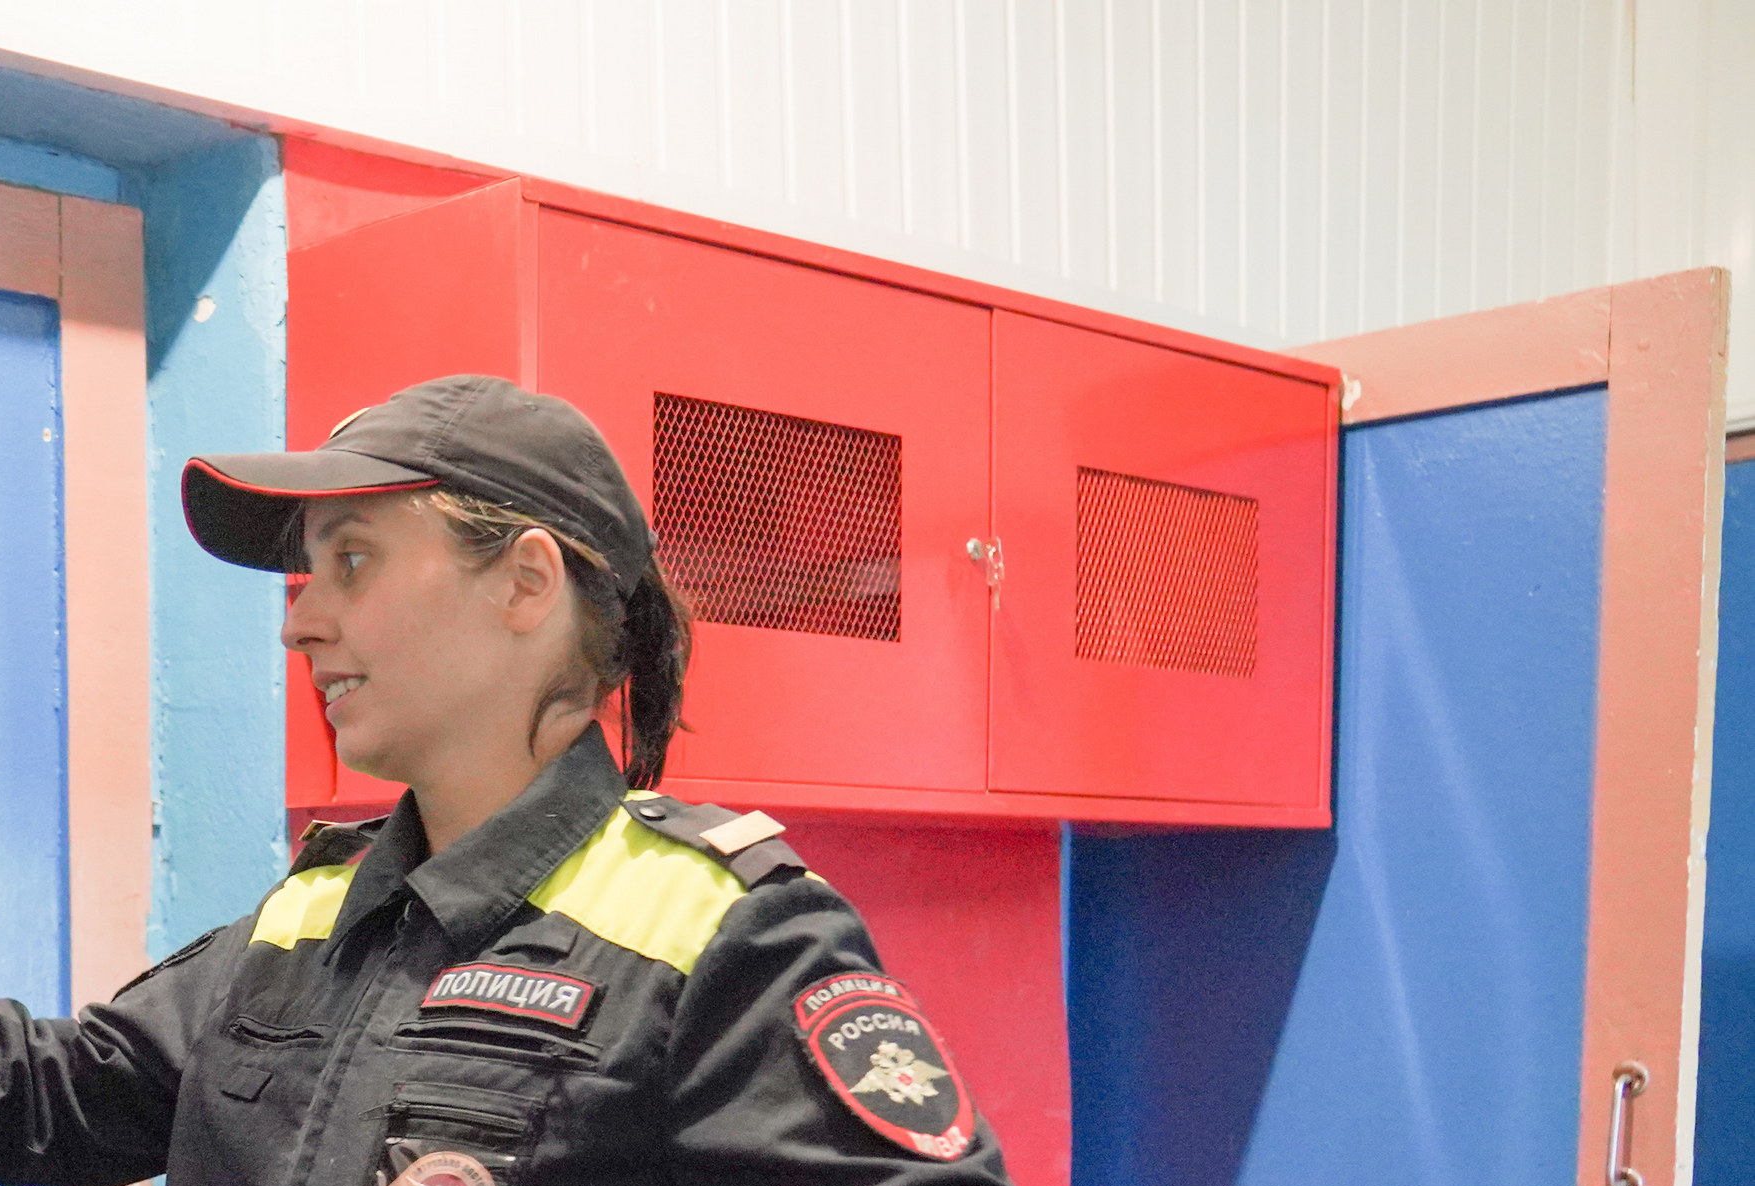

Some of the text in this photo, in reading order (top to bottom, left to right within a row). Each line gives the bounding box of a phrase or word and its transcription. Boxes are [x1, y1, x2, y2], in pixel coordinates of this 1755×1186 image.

[432, 970, 582, 1014] ПОЛИЦИЯ
[804, 977, 899, 1011] ПОЛИЦИЯ
[827, 1012, 921, 1051] РОССИЯ
